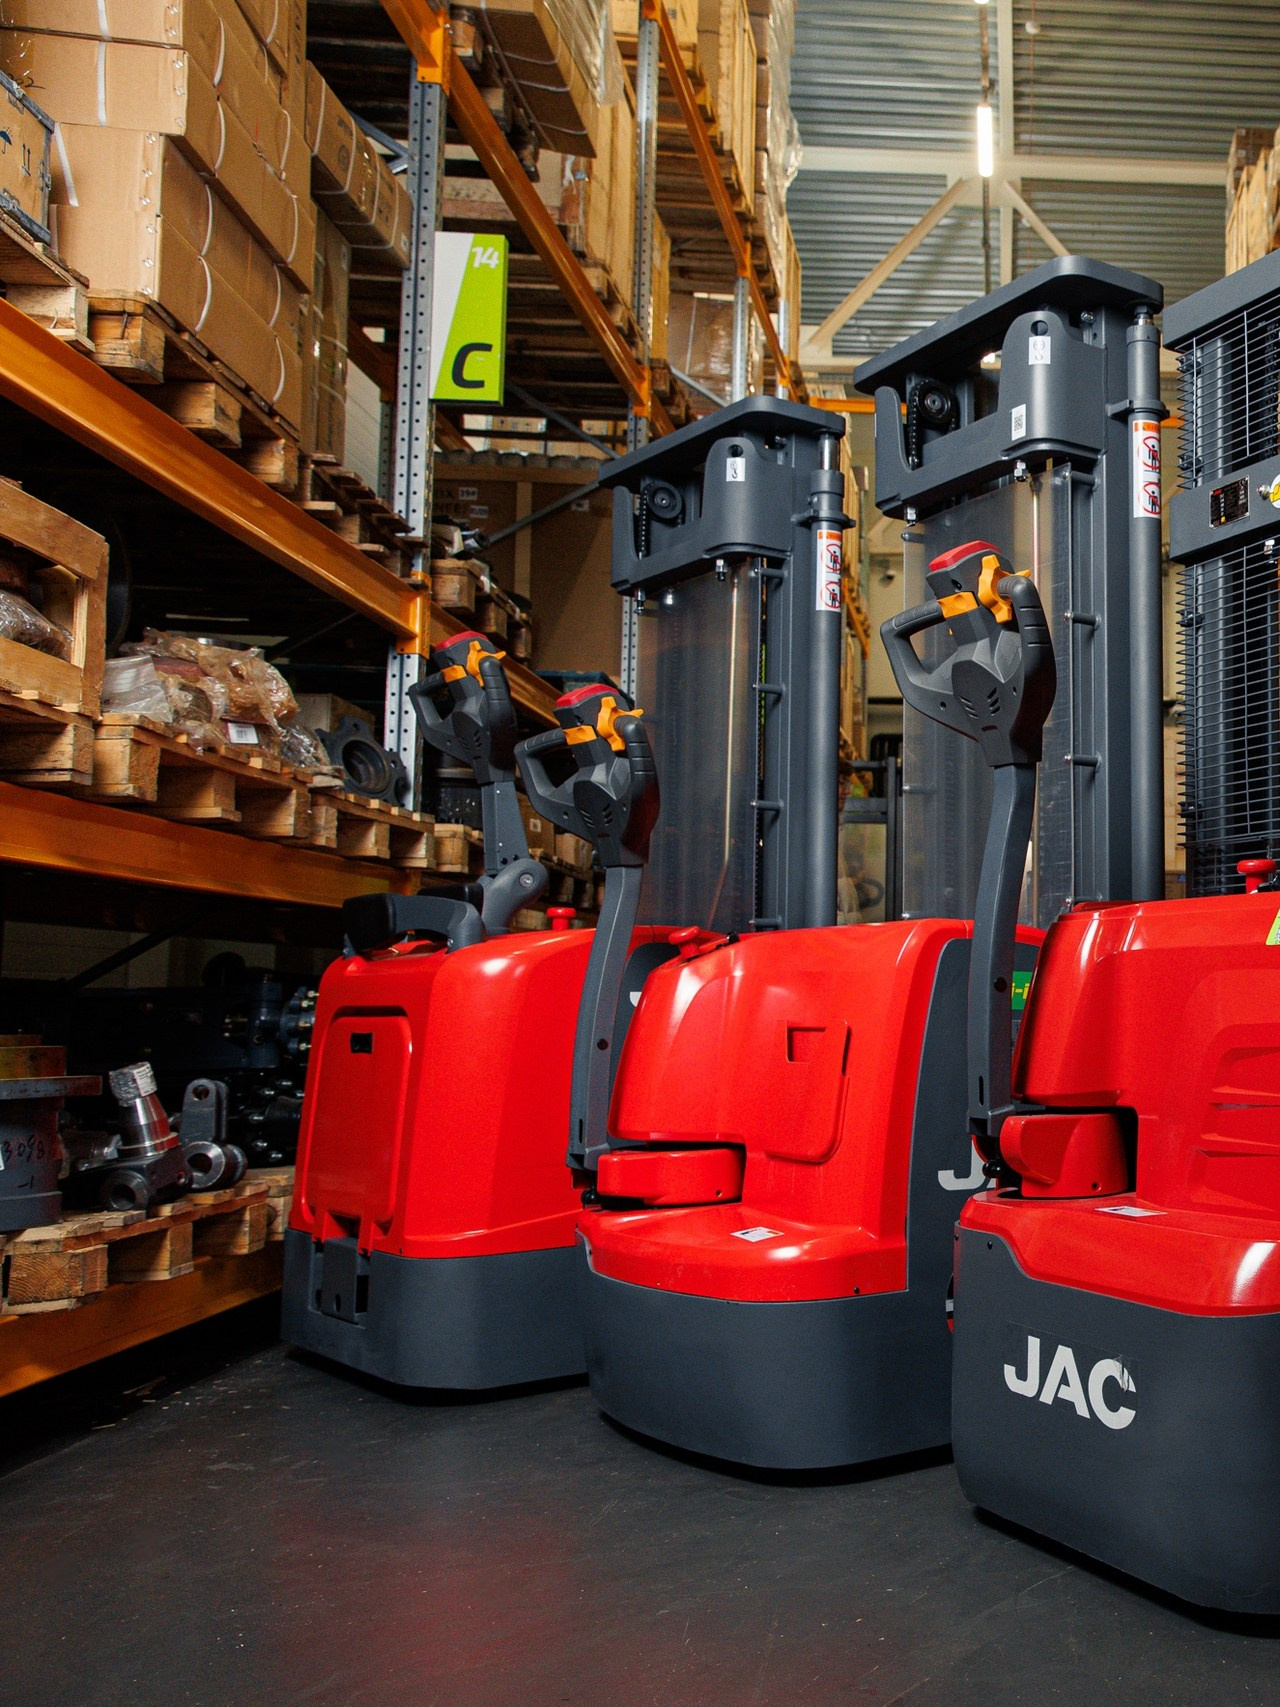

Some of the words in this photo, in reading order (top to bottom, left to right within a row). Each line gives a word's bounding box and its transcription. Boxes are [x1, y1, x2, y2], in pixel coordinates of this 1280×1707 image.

[472, 246, 500, 269] 14
[451, 342, 493, 389] C
[1003, 1335, 1137, 1430] JAC
